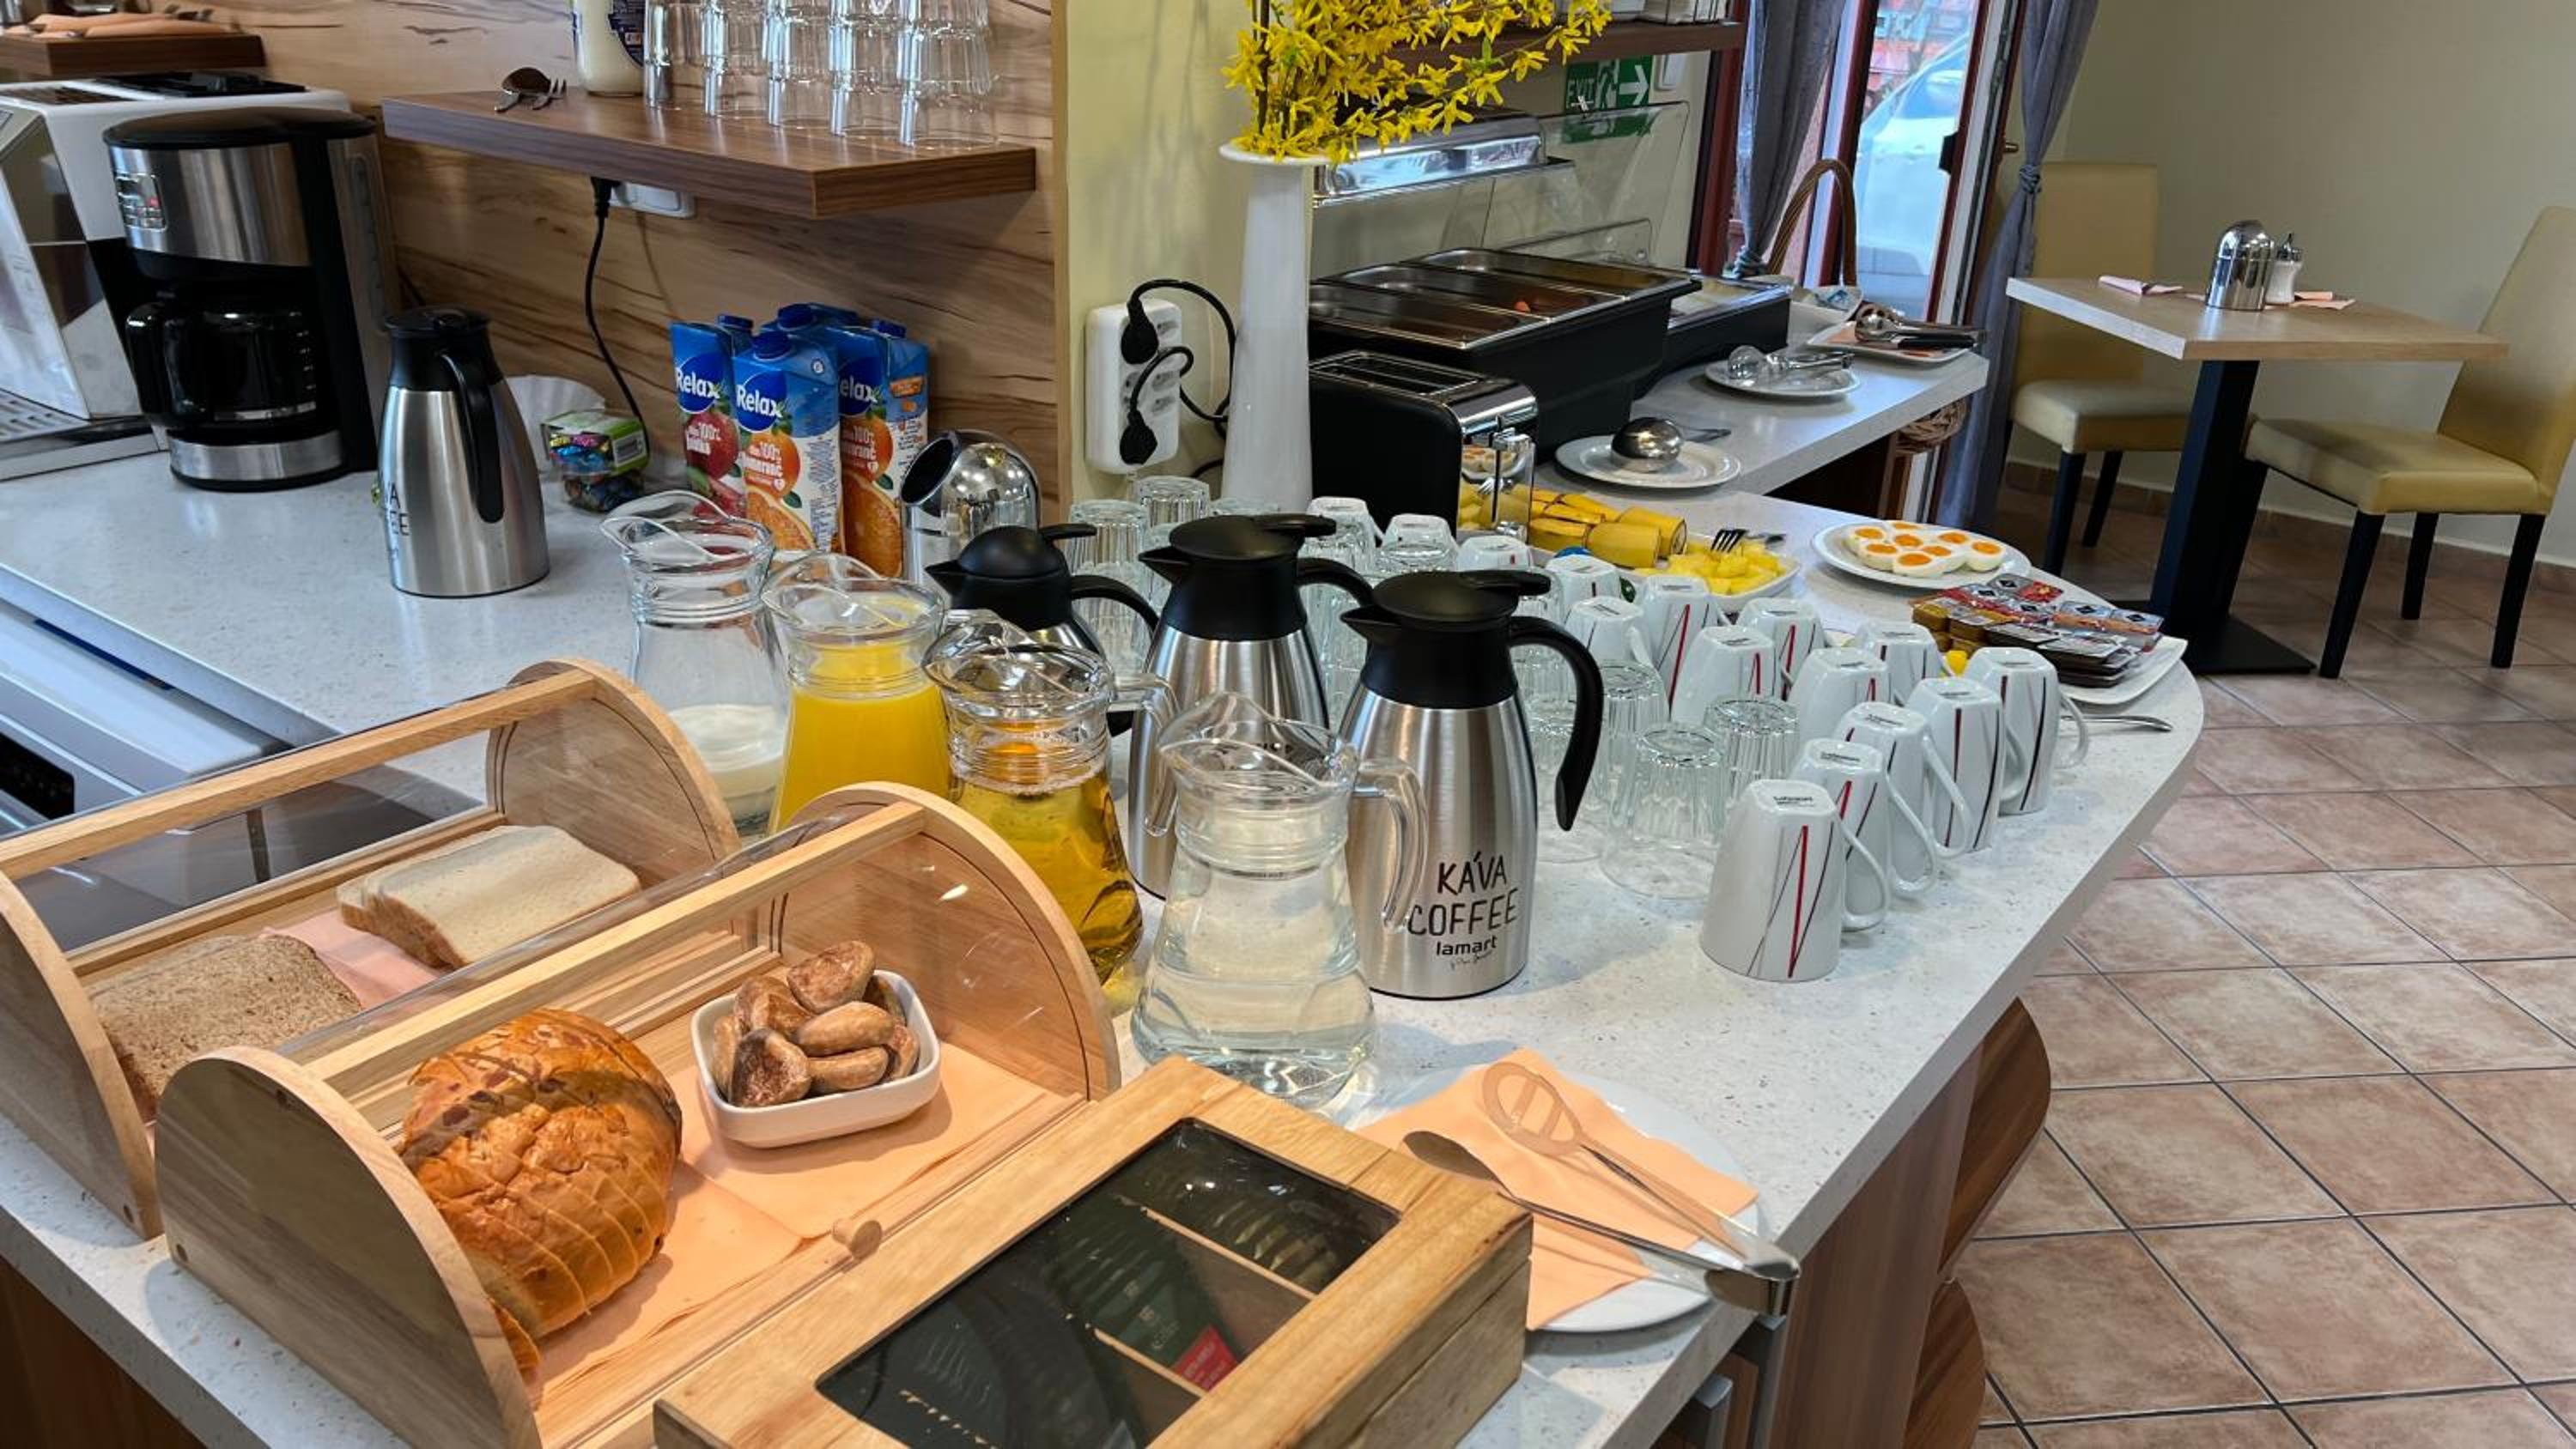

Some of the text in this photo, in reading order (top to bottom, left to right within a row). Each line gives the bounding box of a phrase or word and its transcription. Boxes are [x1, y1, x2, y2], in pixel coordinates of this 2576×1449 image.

[675, 367, 720, 399] Relax
[839, 375, 878, 403] elax
[736, 385, 783, 418] Relax
[1407, 888, 1520, 937] COFFEE
[1436, 935, 1498, 956] lamart
